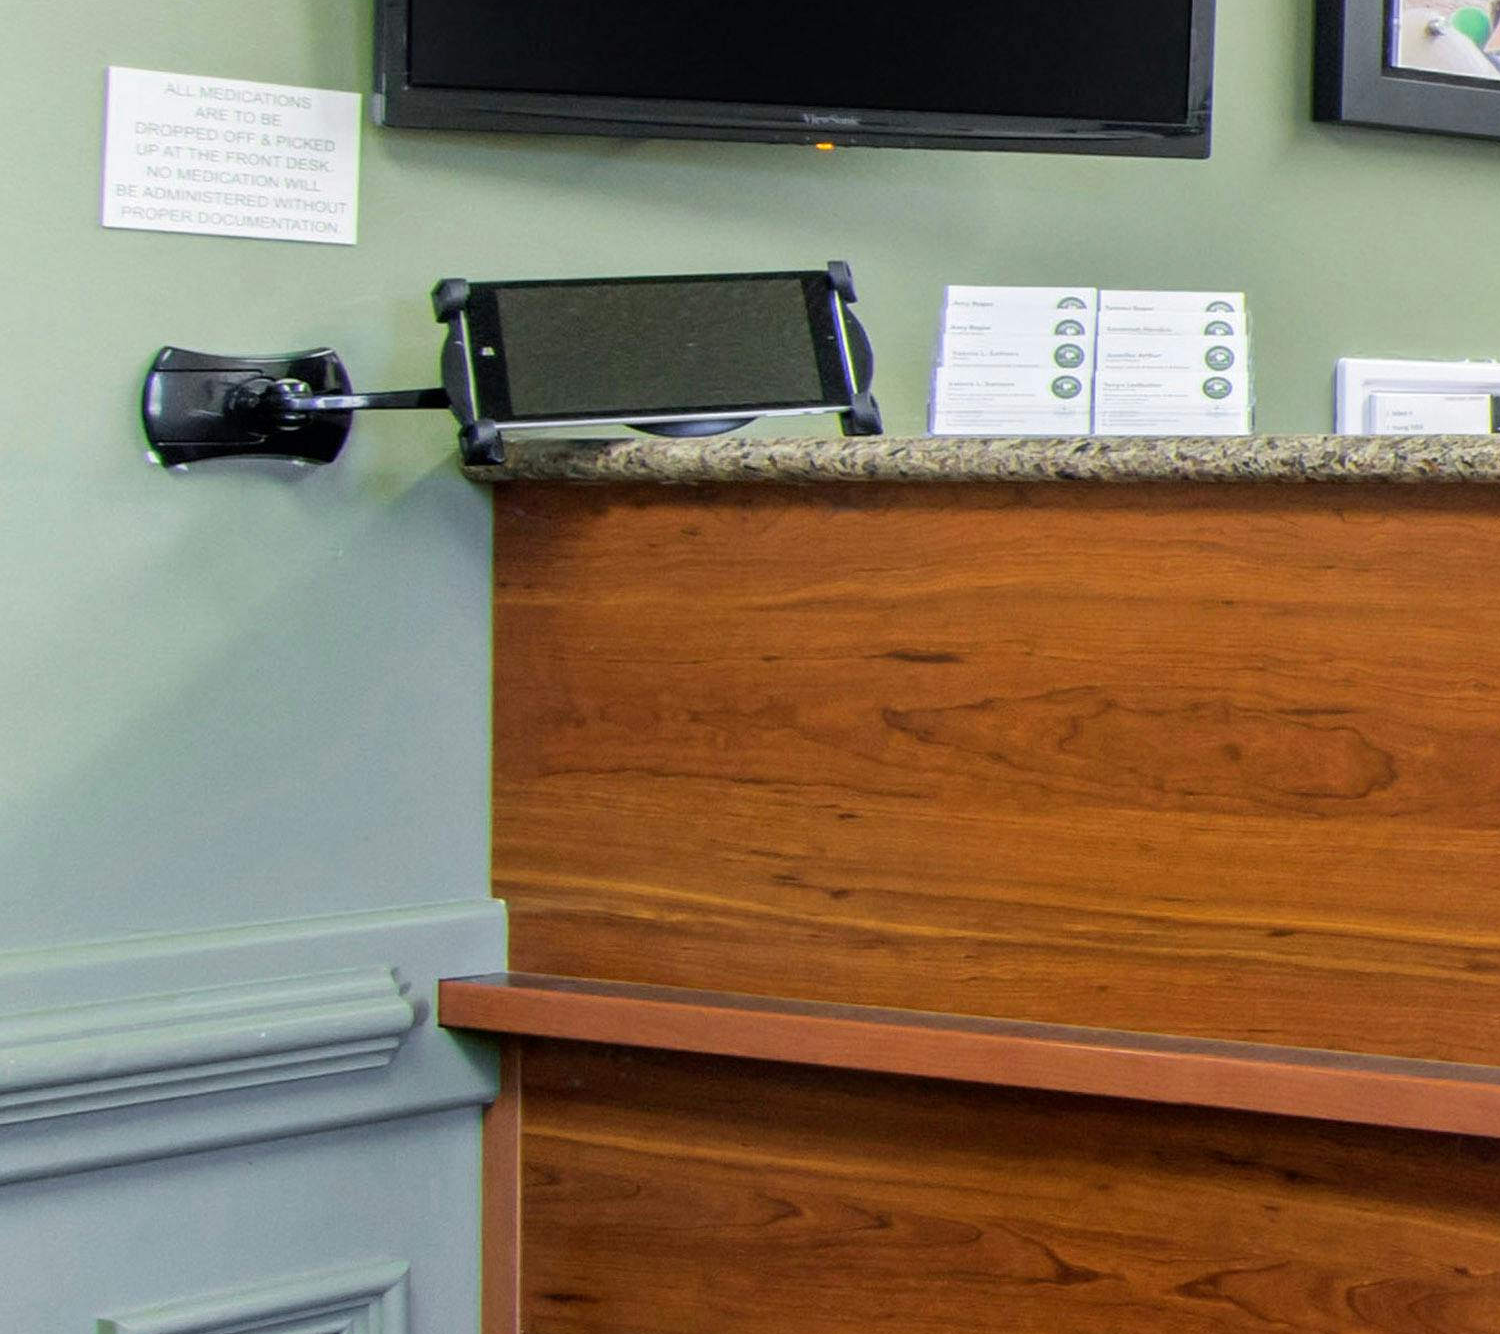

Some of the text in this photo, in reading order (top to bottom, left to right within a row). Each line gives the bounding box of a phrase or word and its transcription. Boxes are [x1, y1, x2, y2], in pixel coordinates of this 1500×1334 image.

[164, 83, 313, 109] ALL MEDICATIONS
[196, 107, 282, 127] ARE TO BE
[135, 121, 336, 153] DROPPED OFF & PICKED
[136, 143, 160, 156] UP
[162, 145, 184, 157] AT
[188, 147, 220, 163] THE
[226, 150, 282, 167] FRONT
[146, 165, 322, 193] NO MEDICATION WILL
[116, 183, 348, 215] BE ADMINISTERED WITHOUT
[121, 206, 190, 223] PROPER
